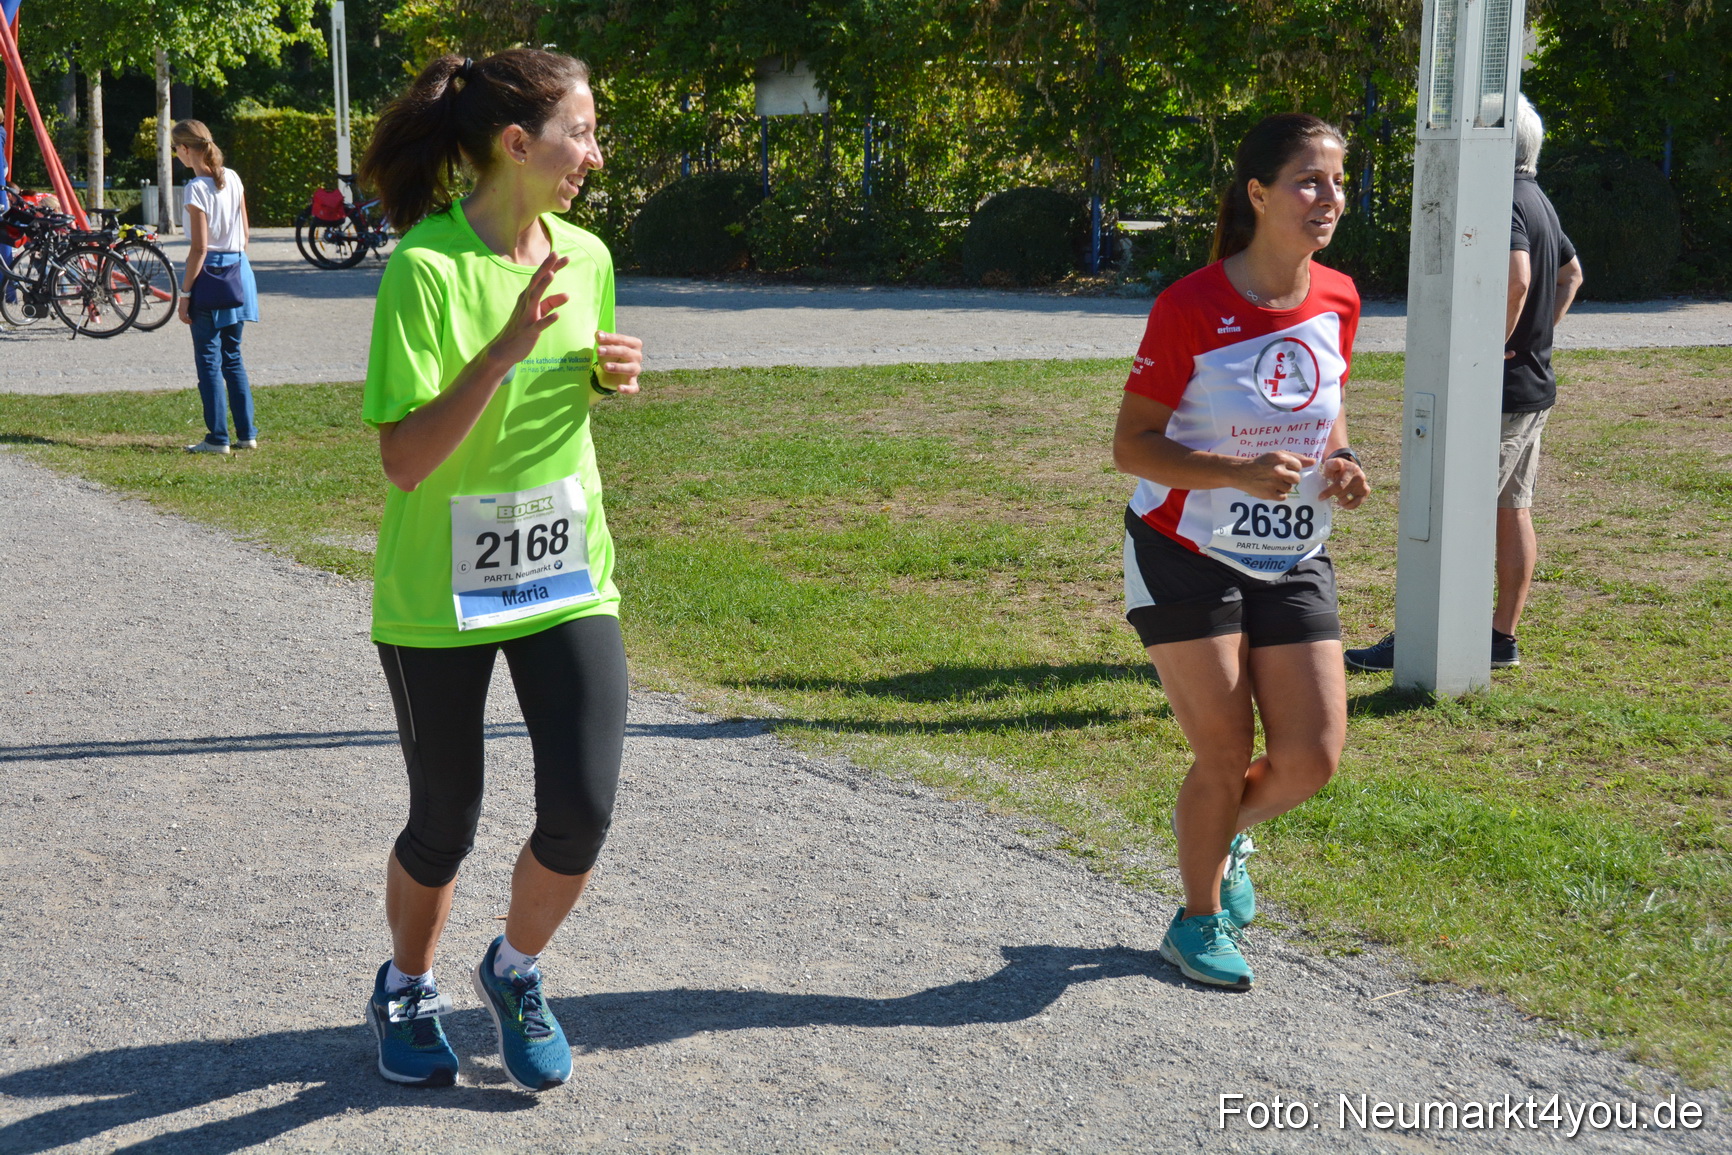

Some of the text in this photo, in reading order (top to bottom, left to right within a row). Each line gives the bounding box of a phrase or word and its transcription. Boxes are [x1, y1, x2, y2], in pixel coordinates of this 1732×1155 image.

[1217, 326, 1241, 334] erima
[1231, 425, 1282, 437] LAUFEN
[1287, 422, 1311, 432] MIT
[1240, 439, 1253, 448] Dr.
[497, 496, 554, 519] BOCK
[1230, 502, 1314, 540] 2638
[475, 518, 569, 570] 2168
[1236, 542, 1295, 551] PARTL Neumarkt
[1241, 556, 1286, 571] Sevinc
[484, 564, 551, 583] PARTL Neumarkt
[502, 584, 549, 606] Maria
